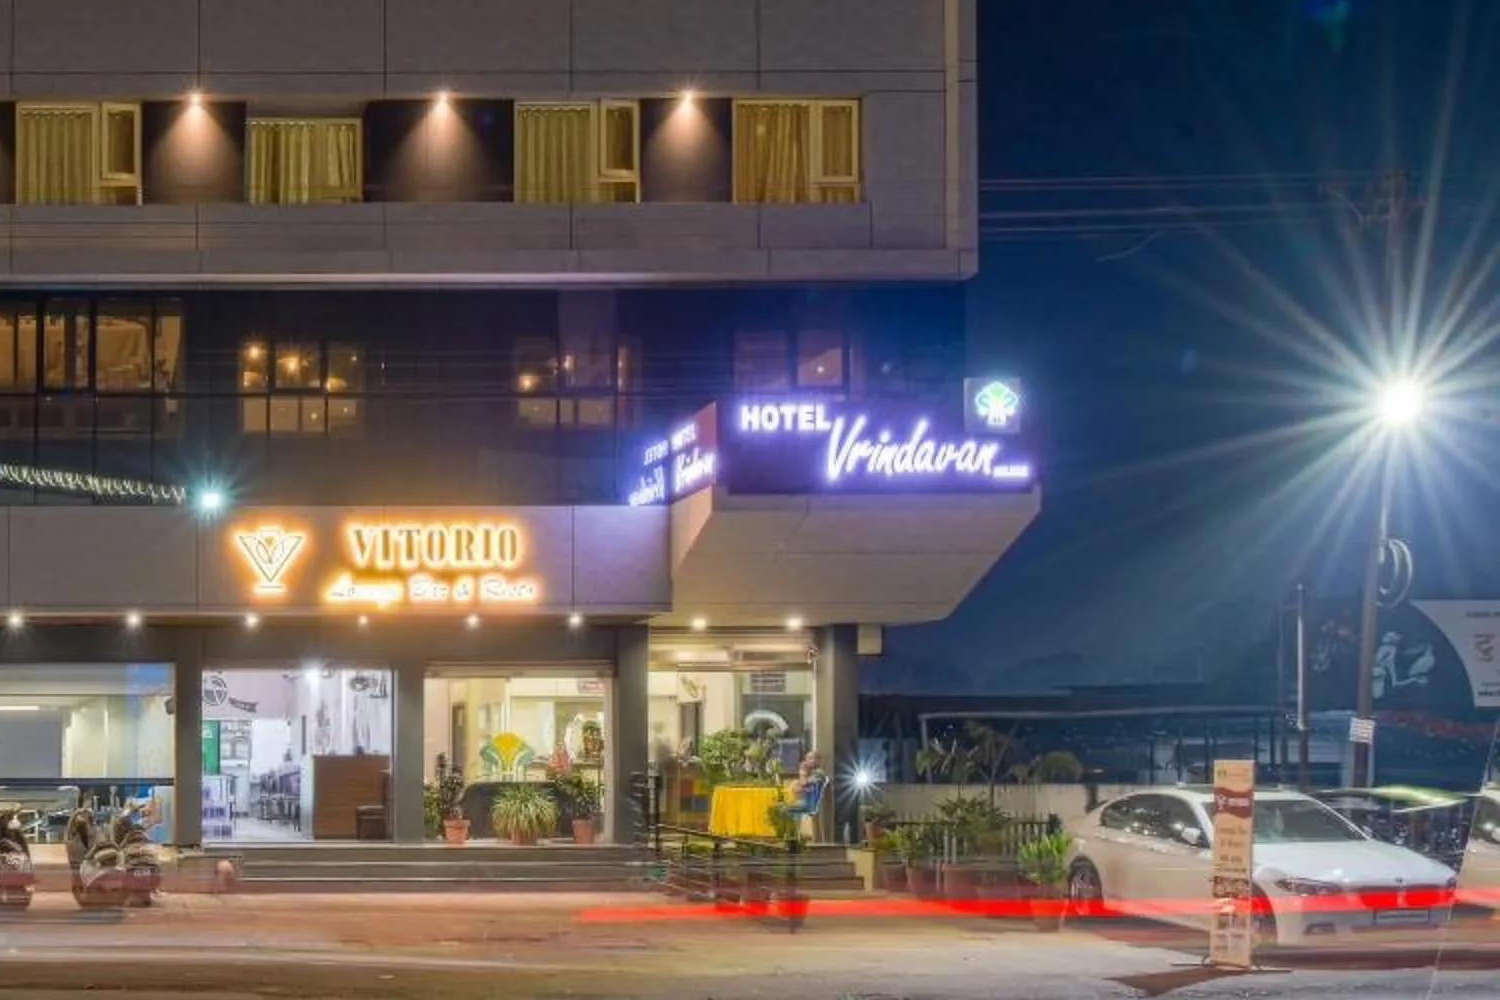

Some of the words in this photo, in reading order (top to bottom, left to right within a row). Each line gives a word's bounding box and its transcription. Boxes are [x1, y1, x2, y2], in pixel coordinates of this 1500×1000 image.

[740, 404, 831, 432] HOTEL
[827, 414, 998, 480] Vrindavan
[349, 525, 521, 568] VITORIO
